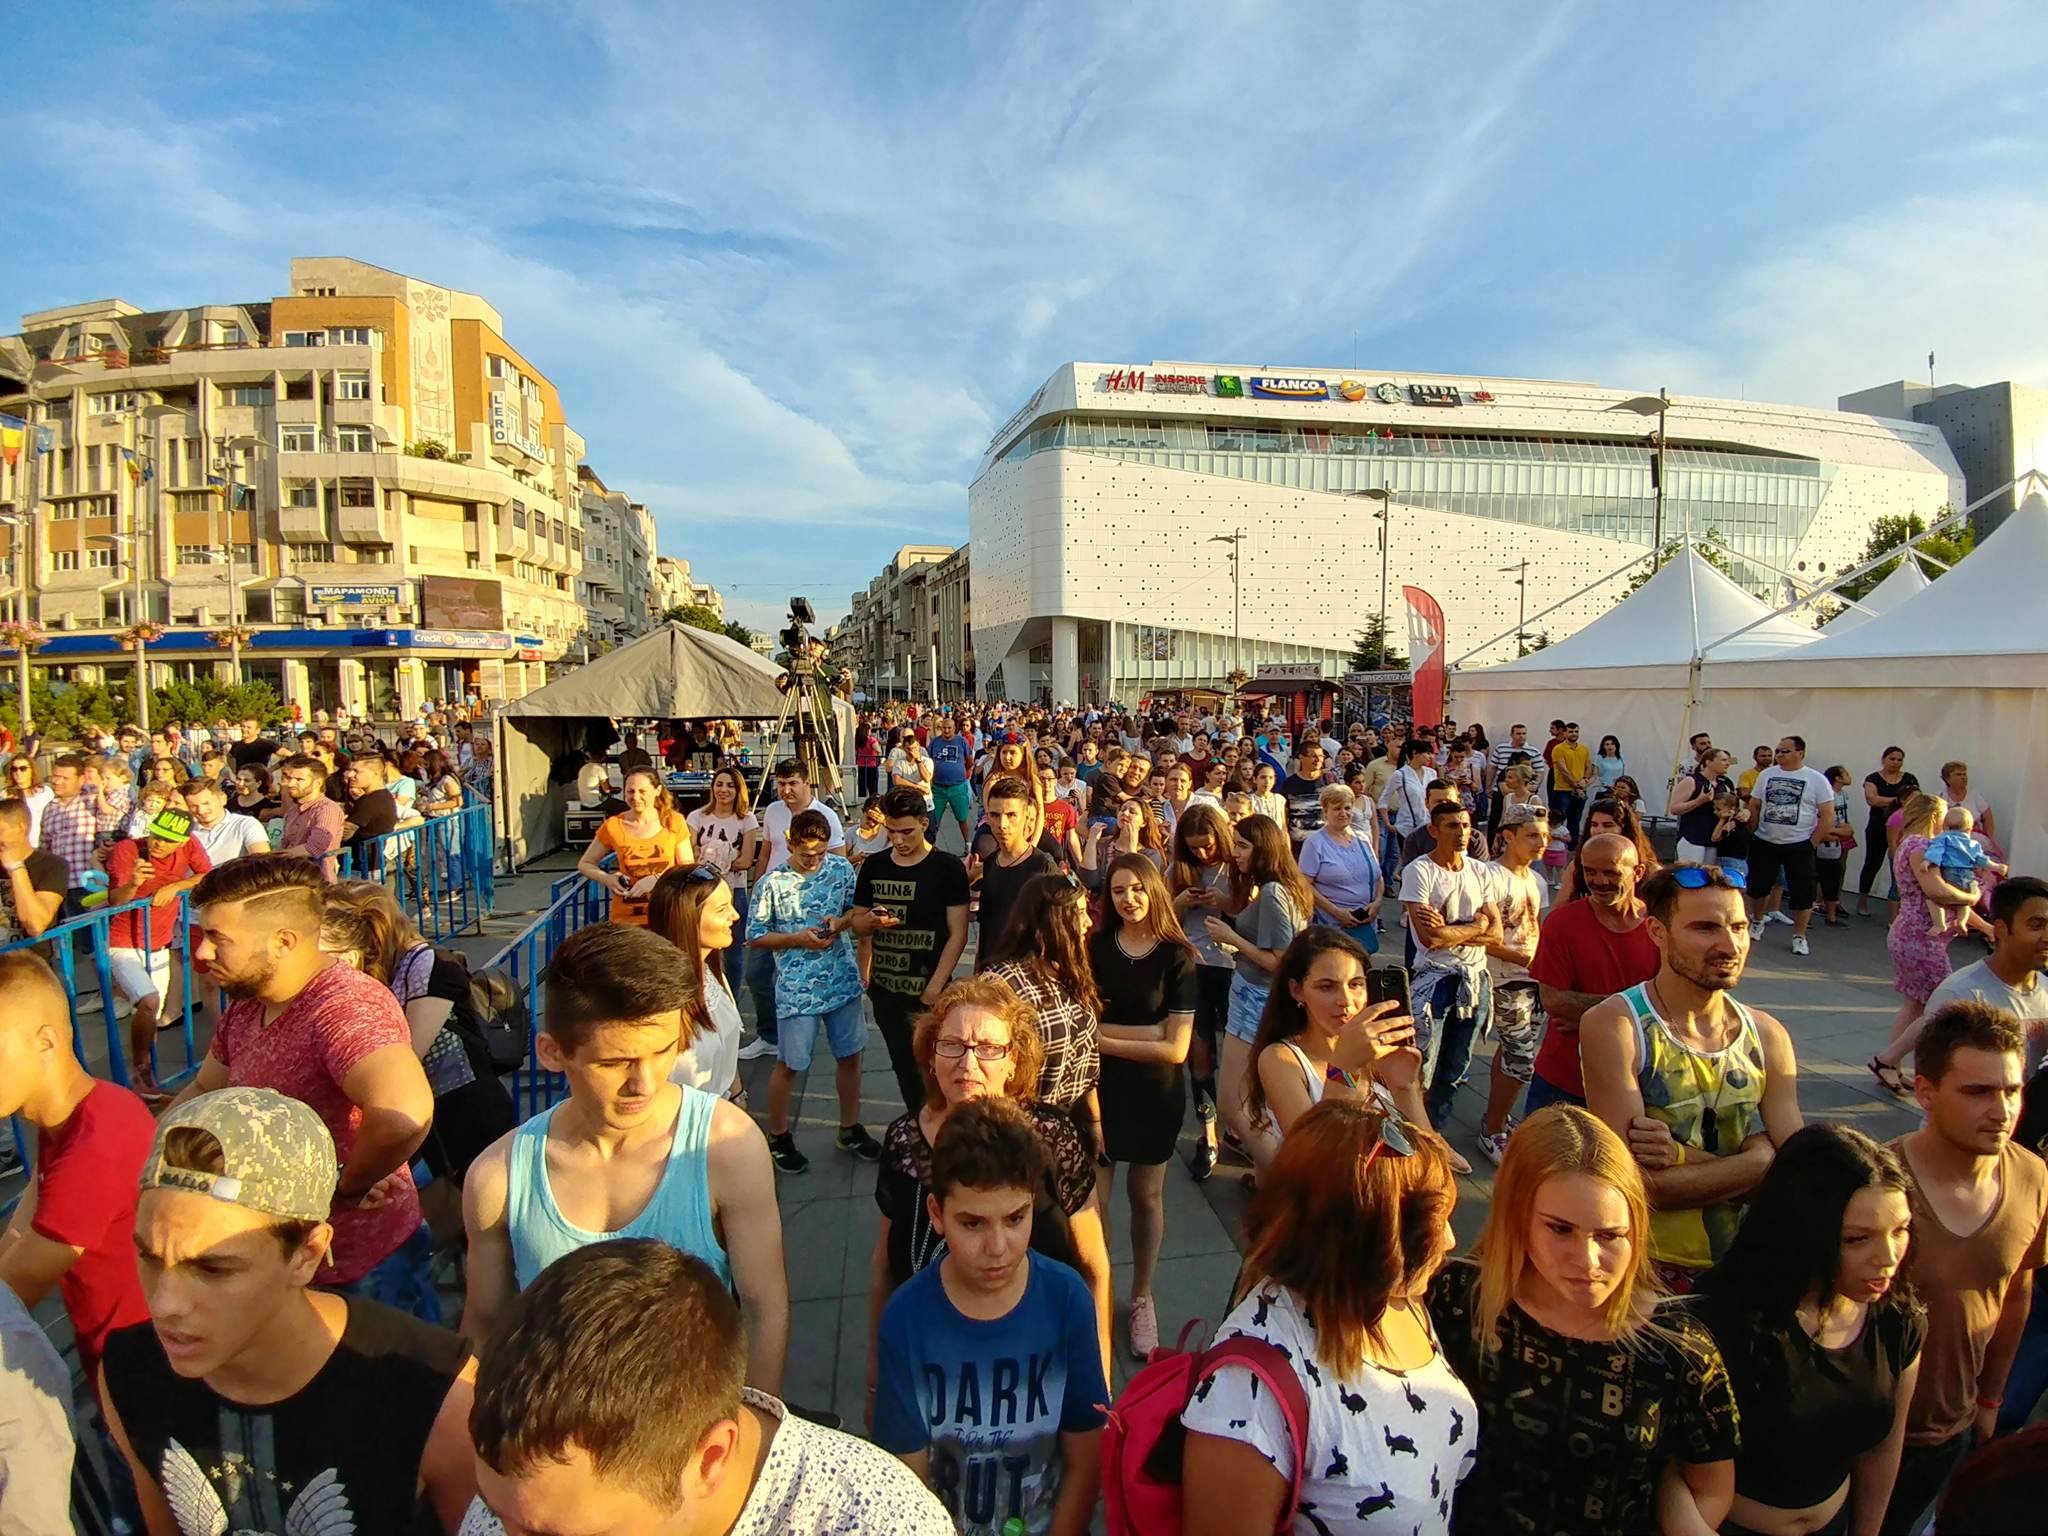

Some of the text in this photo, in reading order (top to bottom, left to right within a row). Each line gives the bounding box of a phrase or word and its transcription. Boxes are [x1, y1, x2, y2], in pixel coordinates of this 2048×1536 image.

[1105, 369, 1145, 392] H&M
[1154, 374, 1207, 385] INSPIRE
[1261, 379, 1320, 390] FLANCO
[494, 395, 505, 440] LERO
[514, 432, 545, 459] LERO
[323, 587, 389, 595] MAPAMOND
[415, 634, 442, 642] Credit
[455, 635, 487, 645] Europe
[924, 1353, 1053, 1426] DARK
